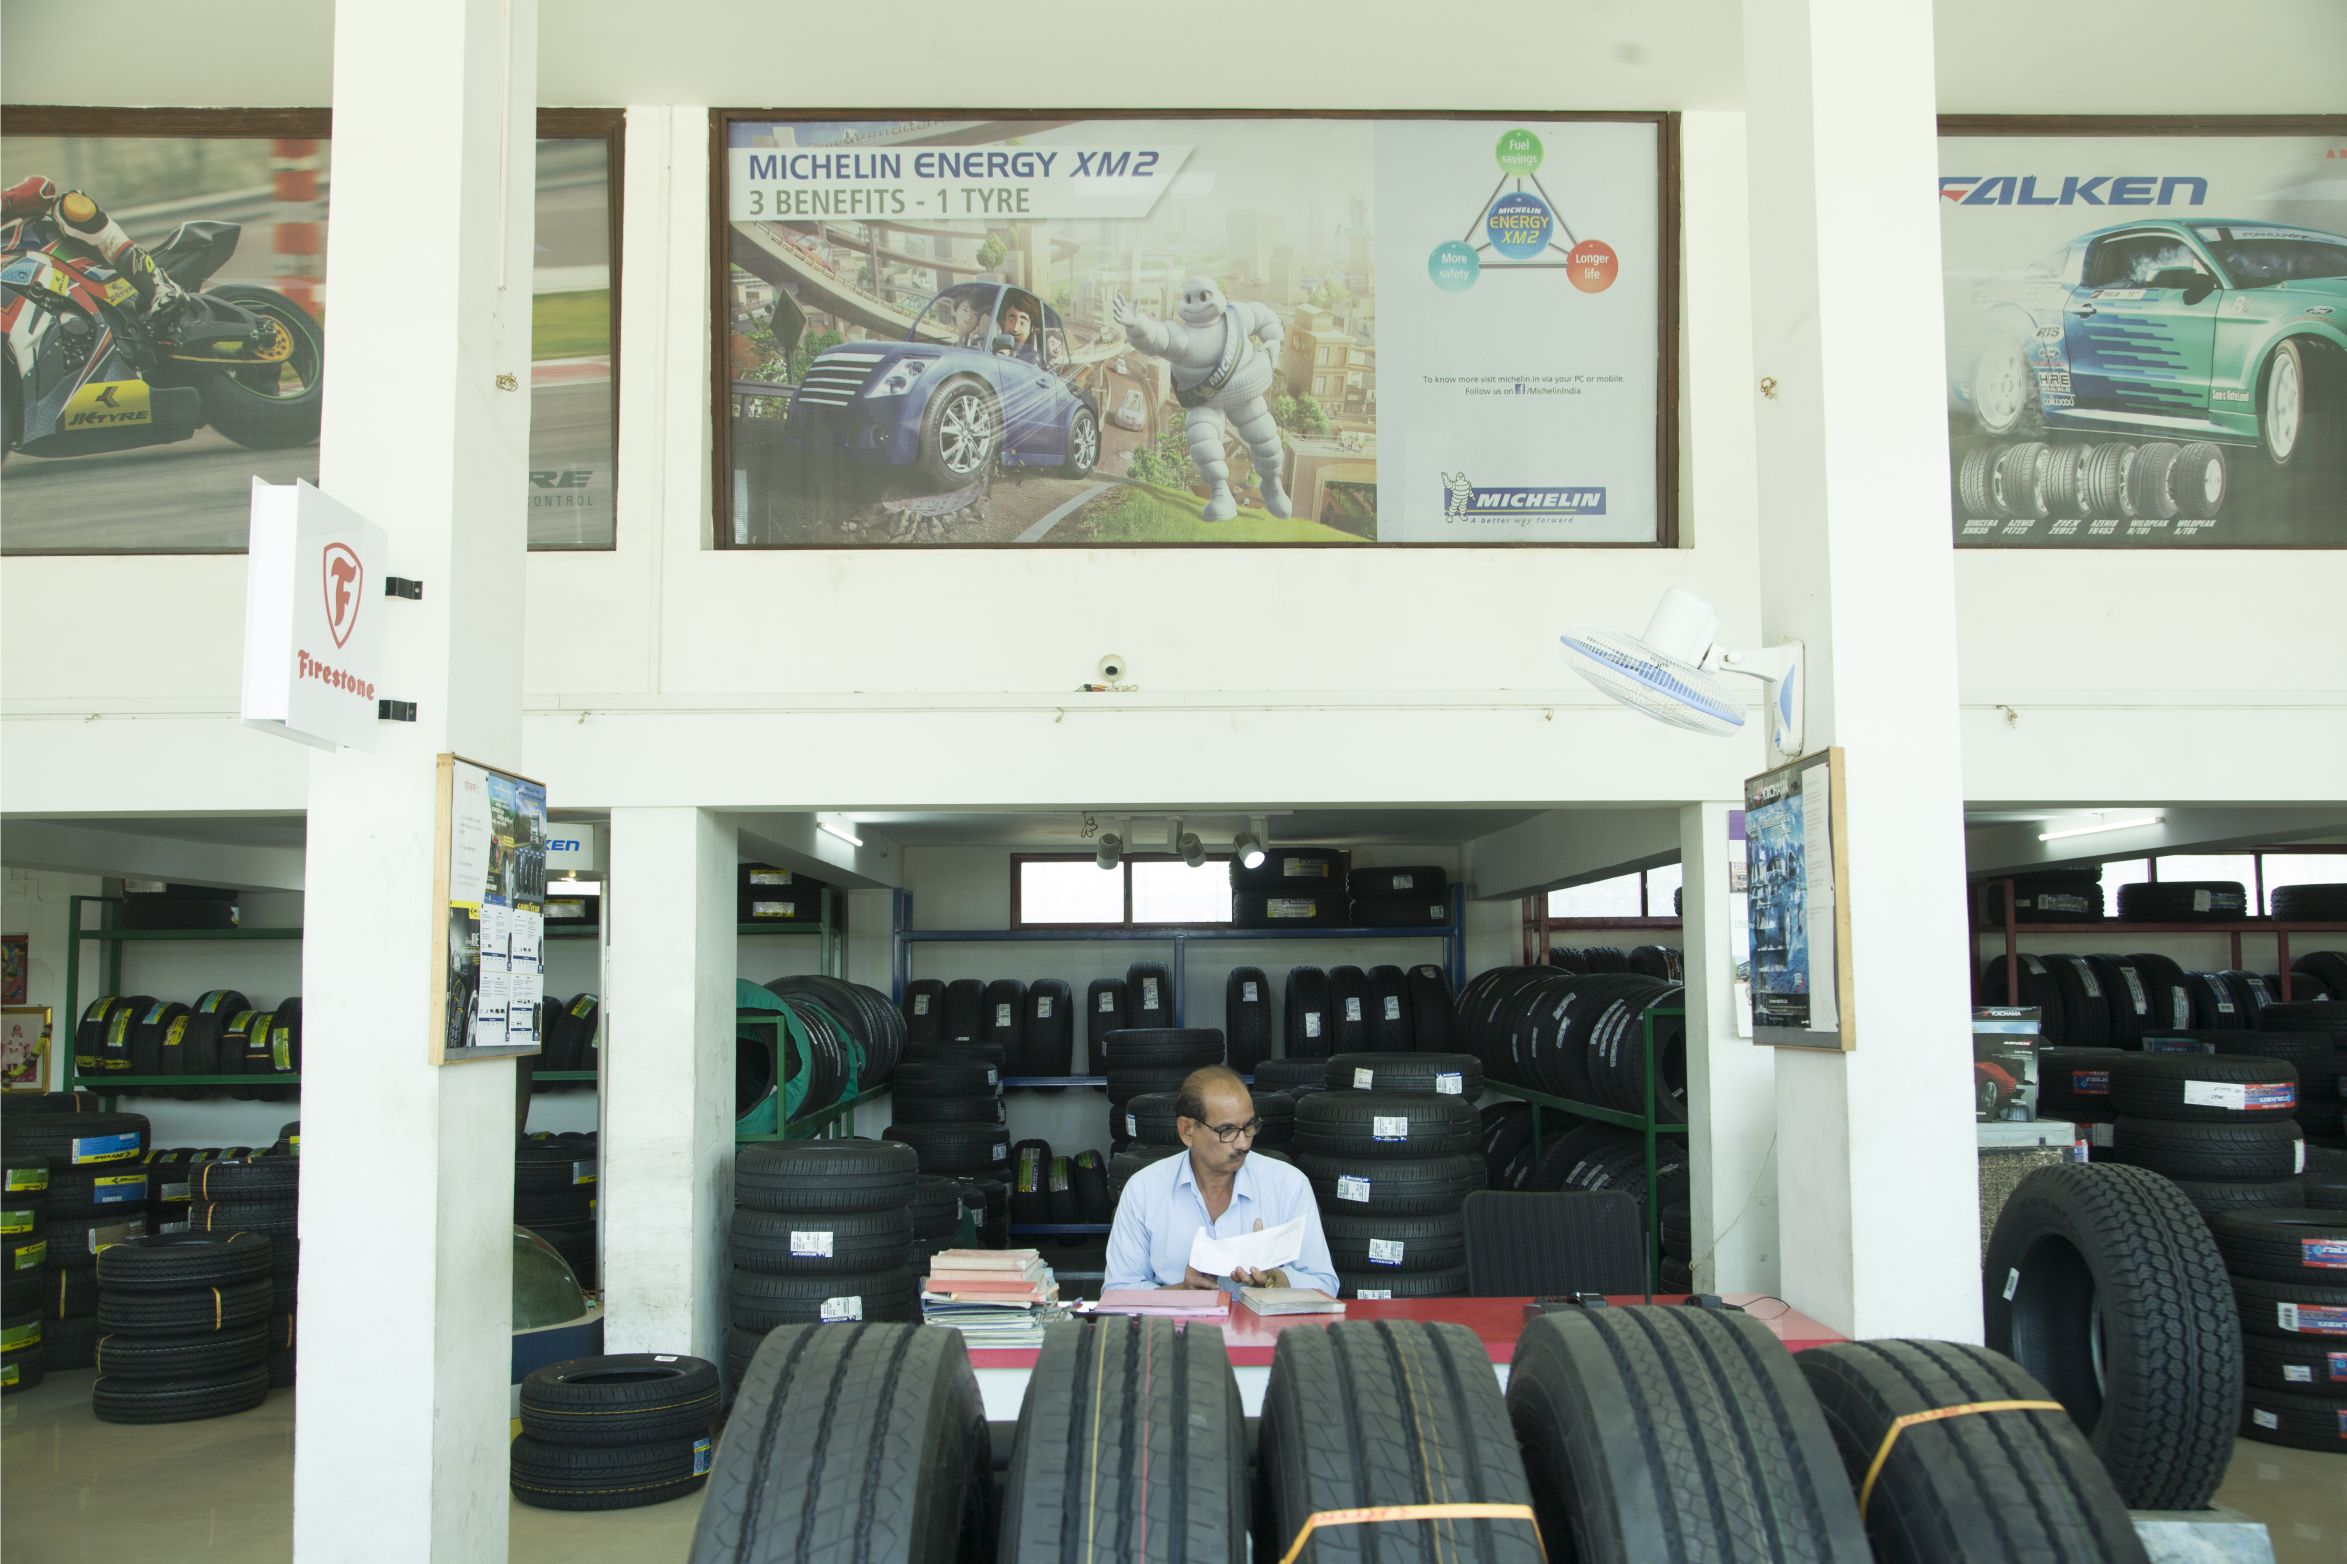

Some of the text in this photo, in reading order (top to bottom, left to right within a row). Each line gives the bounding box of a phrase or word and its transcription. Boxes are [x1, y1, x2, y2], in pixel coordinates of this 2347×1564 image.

[1509, 139, 1530, 151] Fuel
[749, 150, 1161, 180] MICHELIN ENERGY XM2
[1501, 153, 1538, 167] savings
[1939, 175, 2208, 206] FALKEN
[749, 190, 765, 215] 3
[776, 188, 906, 215] BENEFITS
[937, 189, 948, 214] 1
[960, 187, 1031, 214] TYRE
[1498, 206, 1542, 215] MICHELIN
[1489, 215, 1550, 229] ENERGY
[1502, 230, 1539, 245] XM2
[1441, 252, 1468, 264] More
[1575, 253, 1610, 266] Longer
[1439, 267, 1470, 281] safety
[1584, 267, 1601, 280] life
[1423, 375, 1433, 383] To
[1434, 375, 1456, 383] know
[1480, 375, 1495, 383] visit
[1498, 375, 1540, 383] michelin.in
[1542, 375, 1553, 383] via
[1554, 376, 1572, 384] your
[1574, 375, 1585, 383] PC
[1597, 375, 1625, 383] mobile.
[1465, 387, 1491, 395] Follow
[528, 495, 593, 507] ONTROL
[1476, 493, 1601, 508] MICHELIN
[298, 648, 375, 701] Firestone
